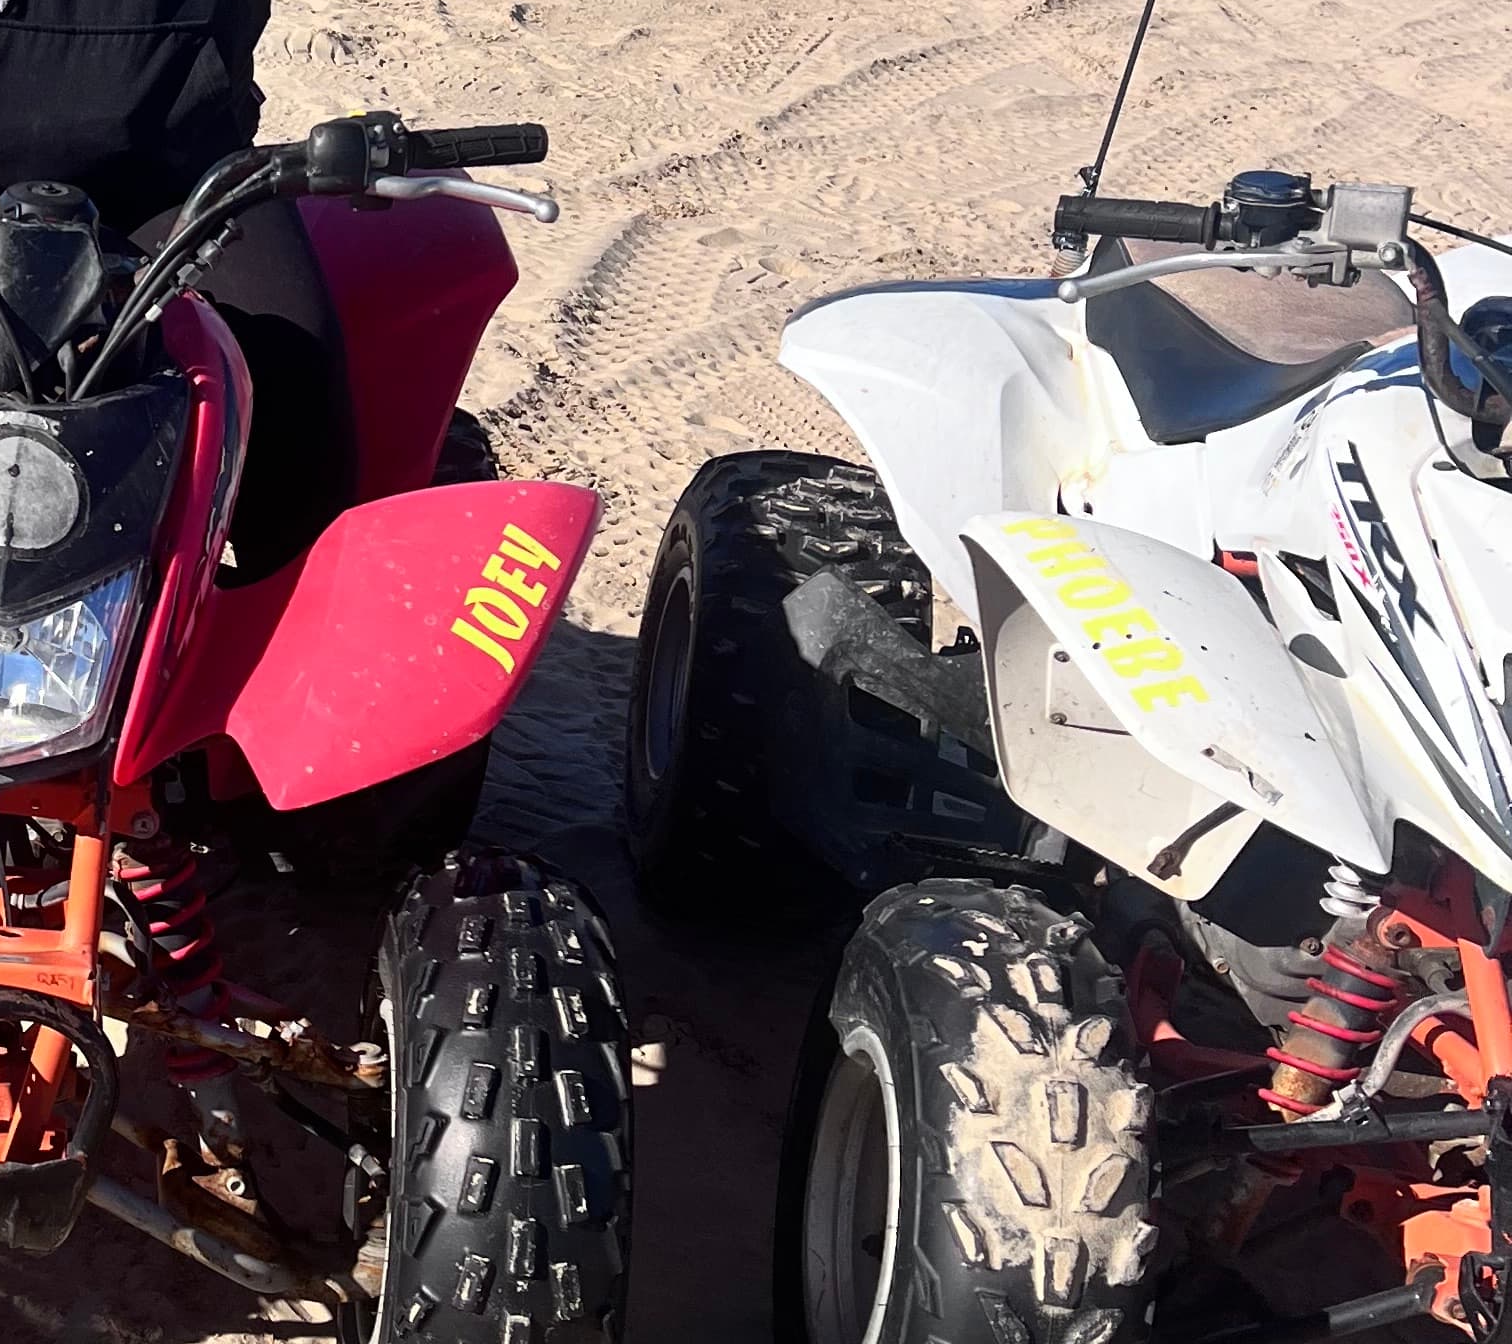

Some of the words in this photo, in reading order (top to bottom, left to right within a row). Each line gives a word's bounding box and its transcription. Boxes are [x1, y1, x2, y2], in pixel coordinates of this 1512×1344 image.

[450, 523, 562, 675] JOEY
[999, 518, 1211, 713] PHOEBE
[1335, 439, 1448, 646] TRX
